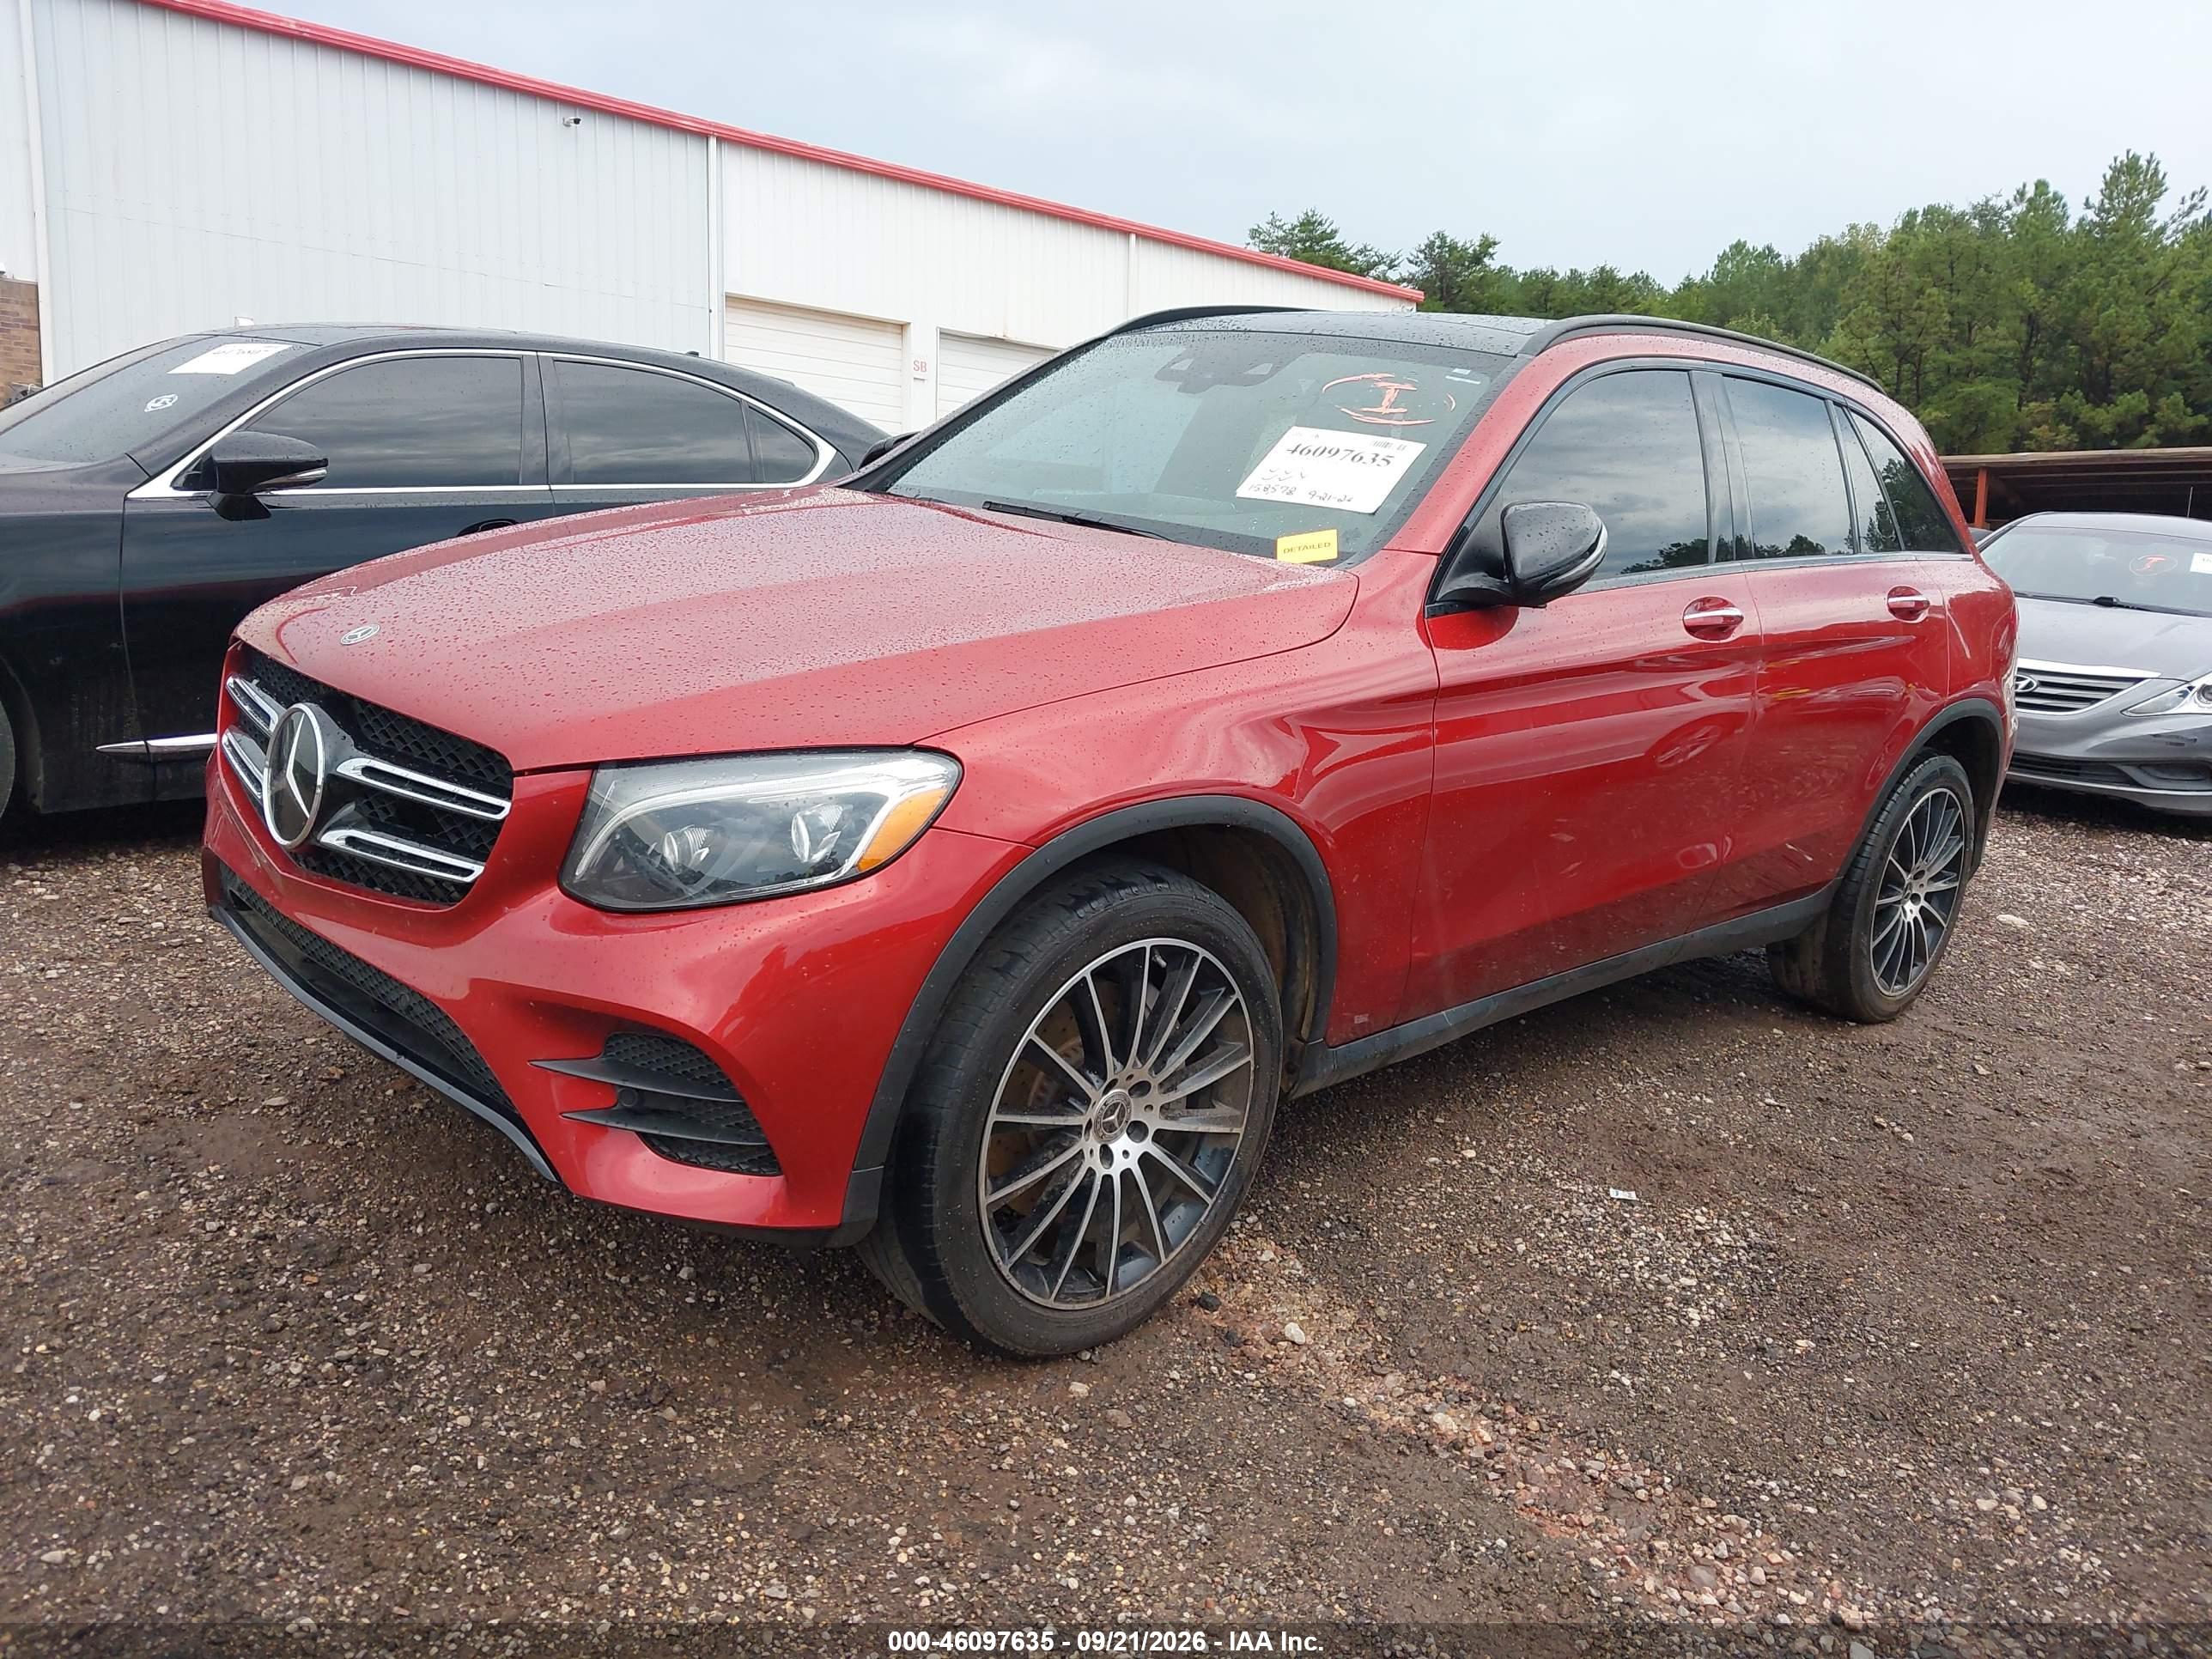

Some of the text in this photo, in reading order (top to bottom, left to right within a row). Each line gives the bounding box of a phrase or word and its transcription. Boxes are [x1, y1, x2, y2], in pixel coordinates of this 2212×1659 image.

[913, 359, 927, 373] SB
[1286, 442, 1395, 468] 46097635
[1283, 542, 1332, 554] DETAILED
